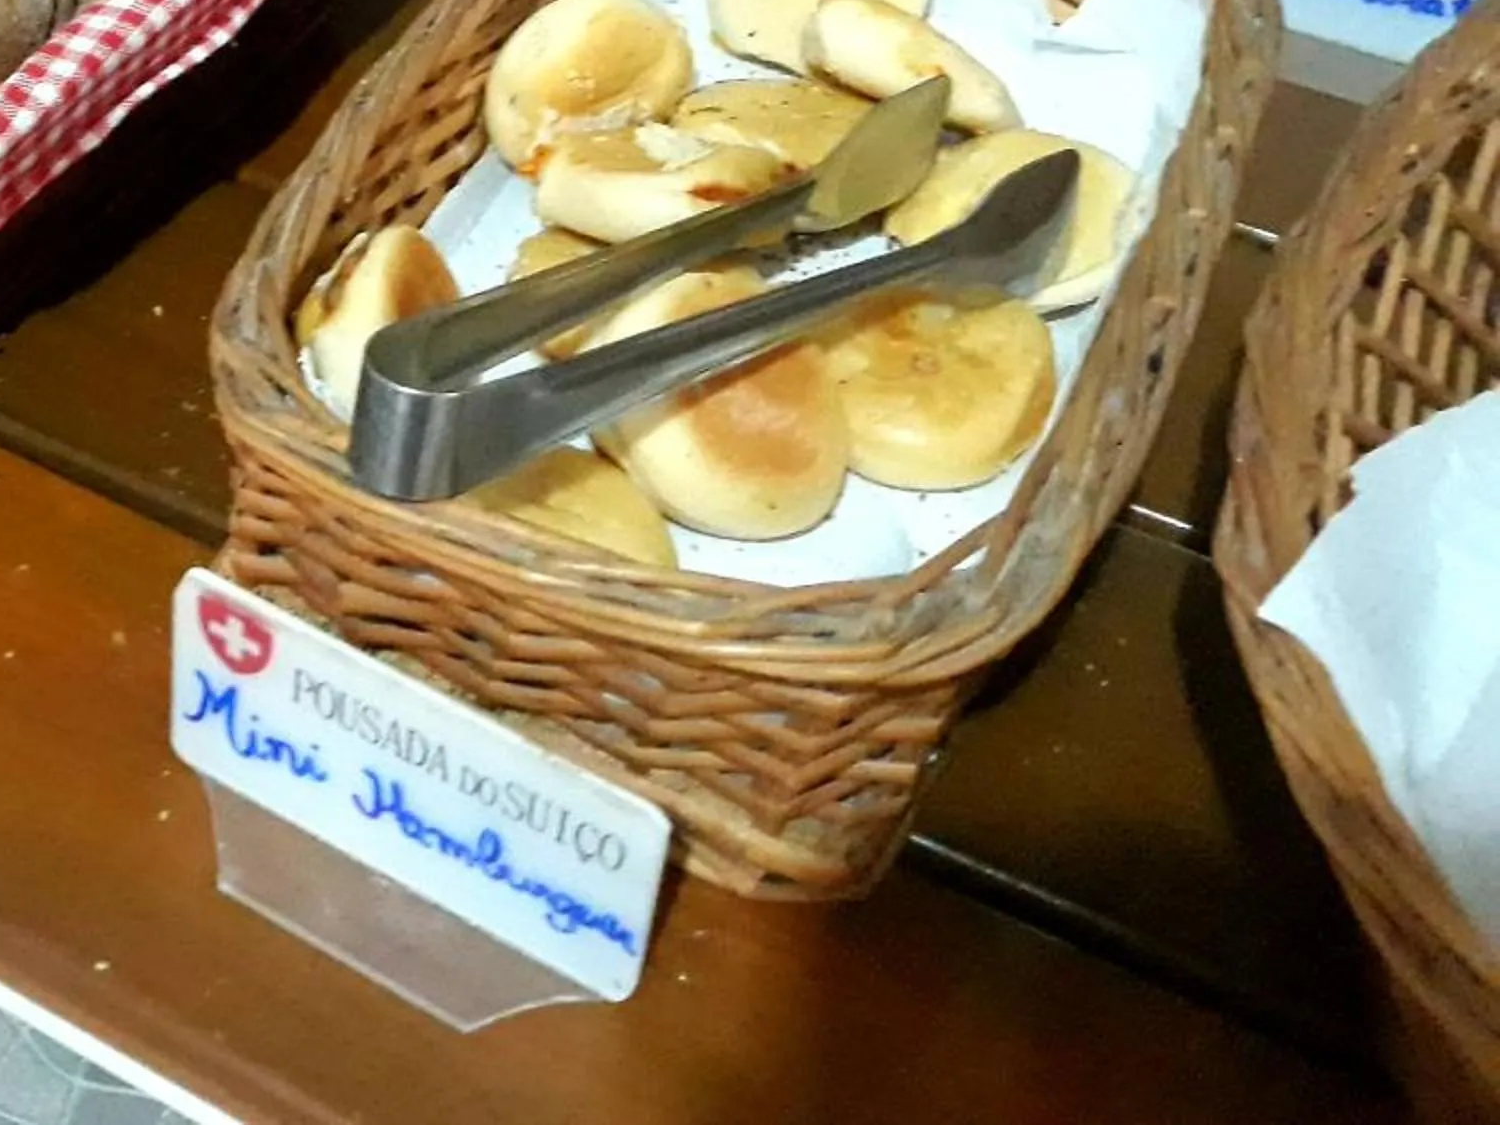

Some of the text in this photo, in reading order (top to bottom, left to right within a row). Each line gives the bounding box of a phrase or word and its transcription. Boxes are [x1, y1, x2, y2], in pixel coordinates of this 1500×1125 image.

[183, 669, 327, 783] Mini
[290, 668, 628, 873] POUSADA DO SUIÇO
